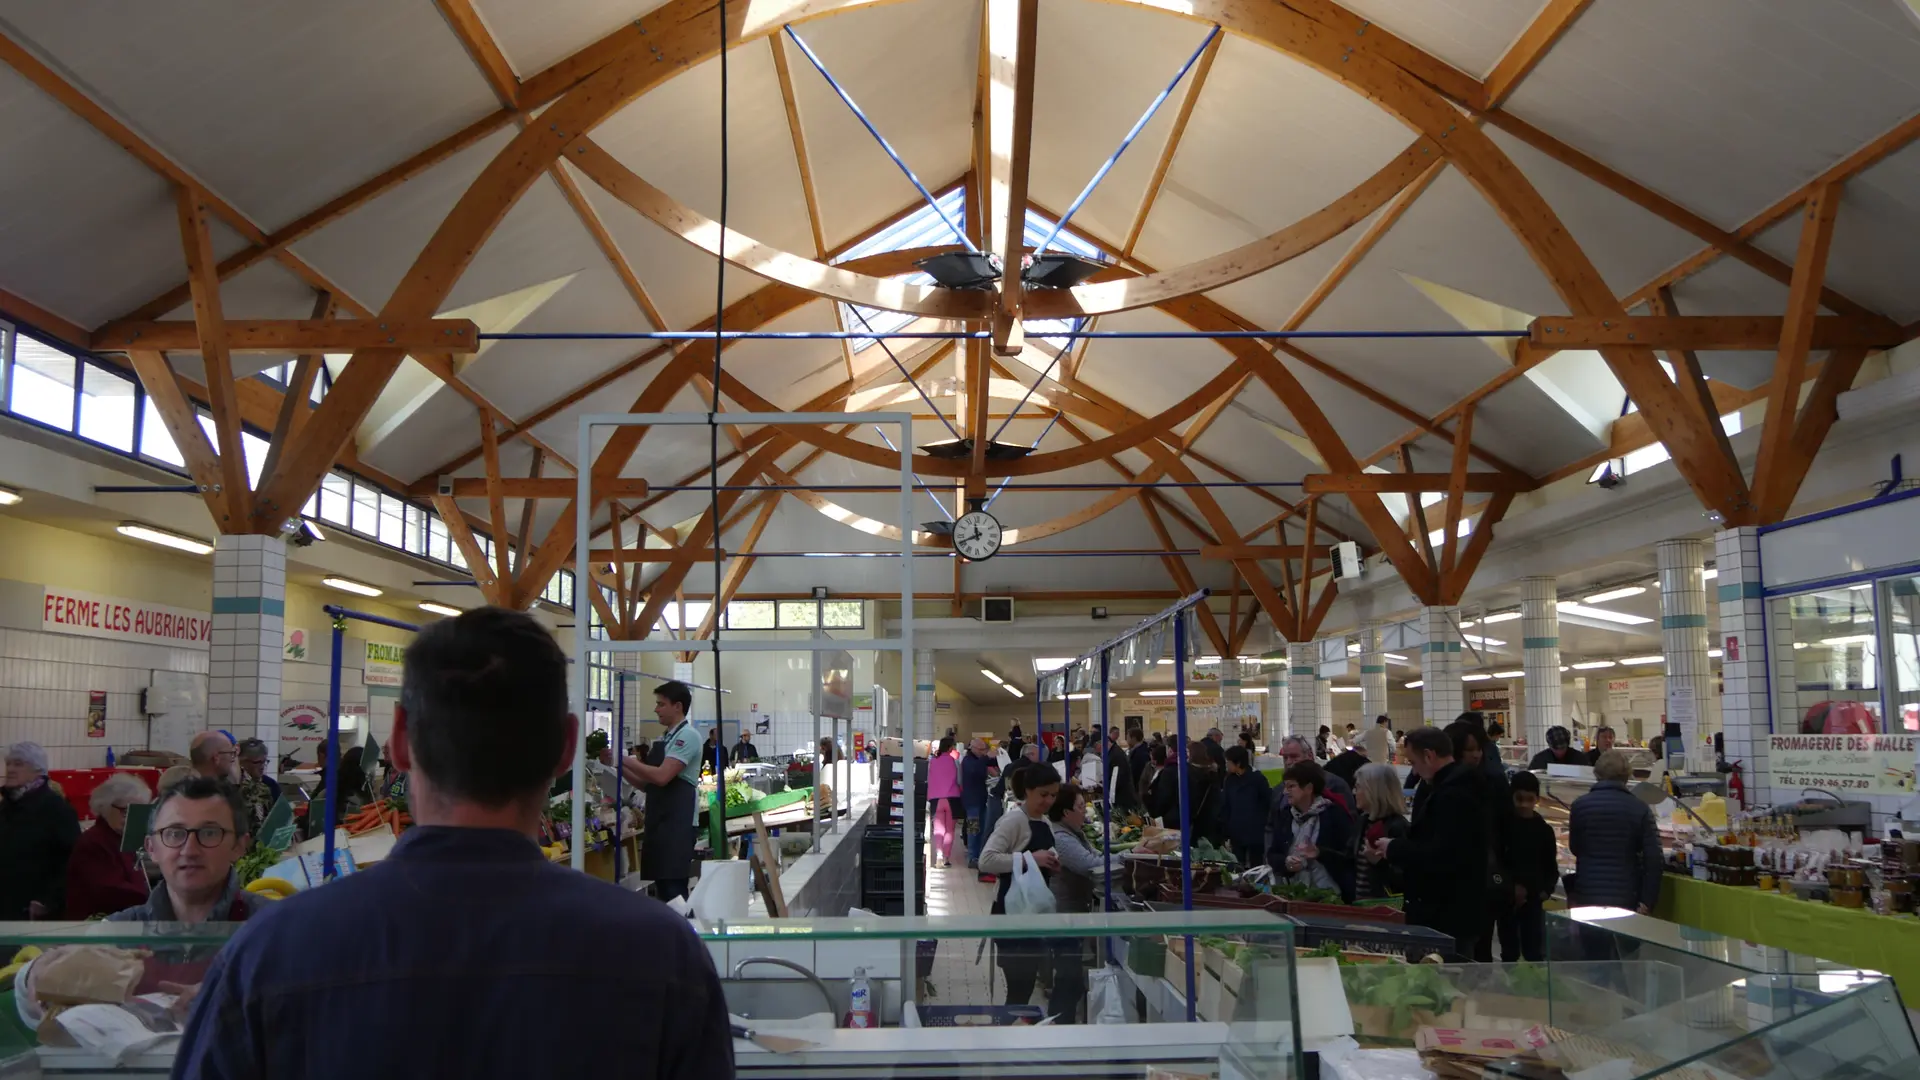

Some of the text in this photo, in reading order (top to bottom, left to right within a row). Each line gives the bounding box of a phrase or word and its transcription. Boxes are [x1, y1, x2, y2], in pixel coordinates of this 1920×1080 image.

[44, 594, 100, 628] FERME
[104, 603, 131, 632] LES
[134, 609, 198, 641] AUBRIAIS
[1771, 736, 1843, 752] FROMAGERIE
[1847, 737, 1869, 751] DES
